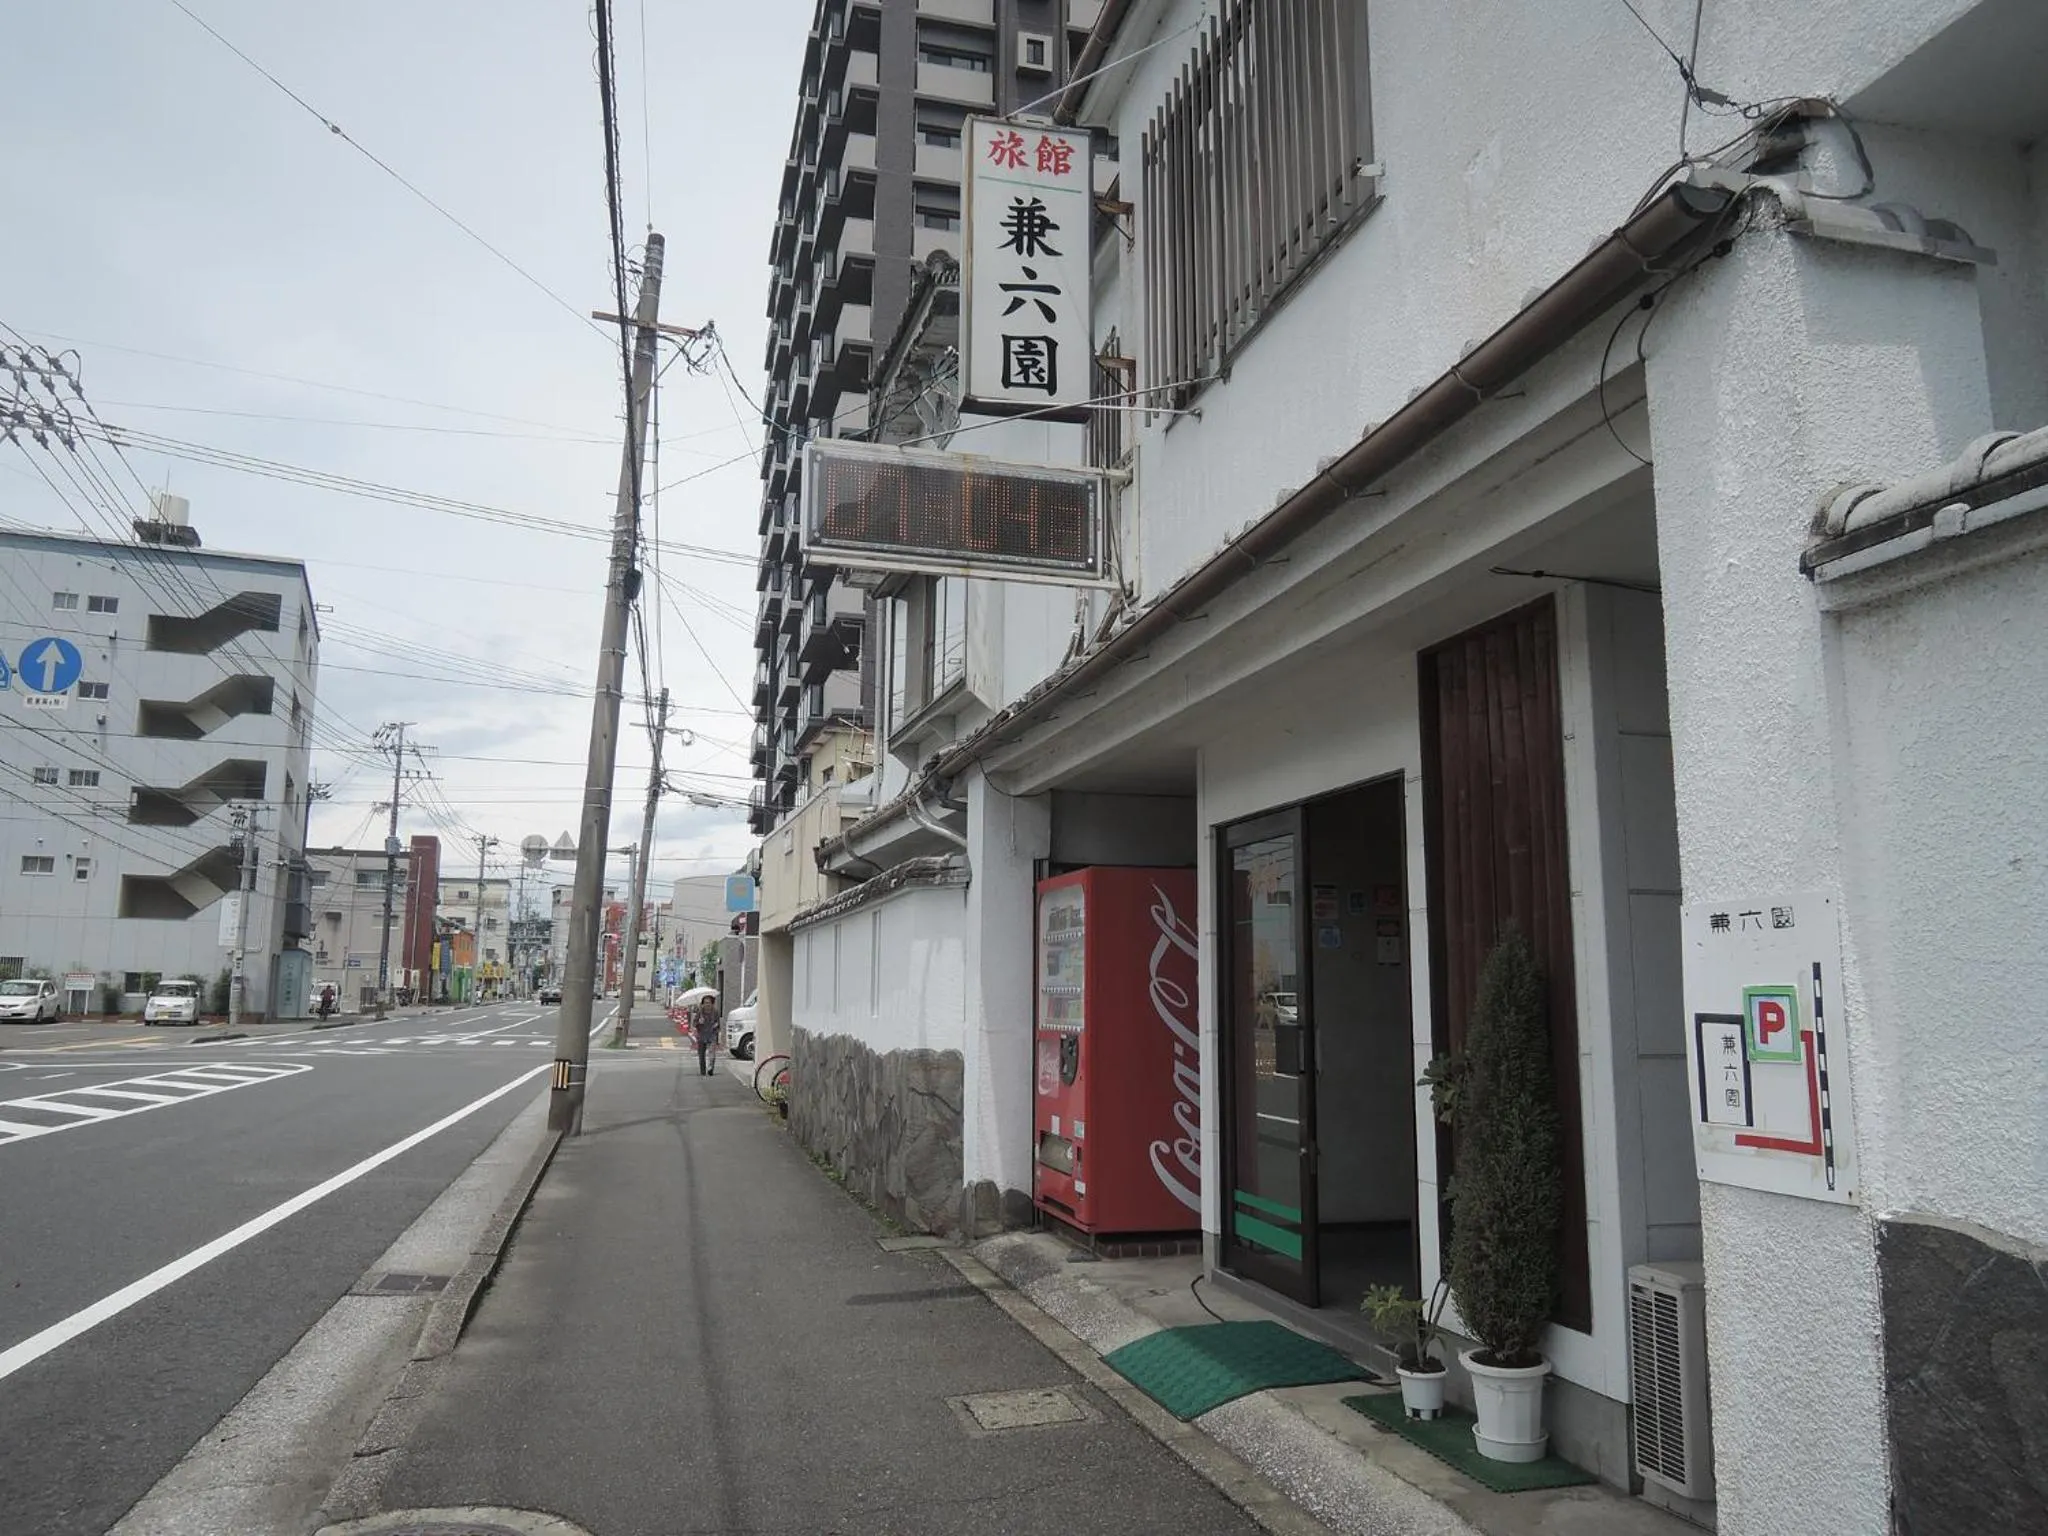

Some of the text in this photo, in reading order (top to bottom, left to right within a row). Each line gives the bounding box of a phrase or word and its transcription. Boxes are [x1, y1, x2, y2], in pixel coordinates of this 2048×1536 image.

[987, 130, 1077, 177] 旅館
[997, 196, 1064, 397] 兼六園
[1709, 905, 1796, 933] 兼六園
[1757, 1000, 1786, 1045] P
[1720, 1033, 1741, 1109] 兼六園
